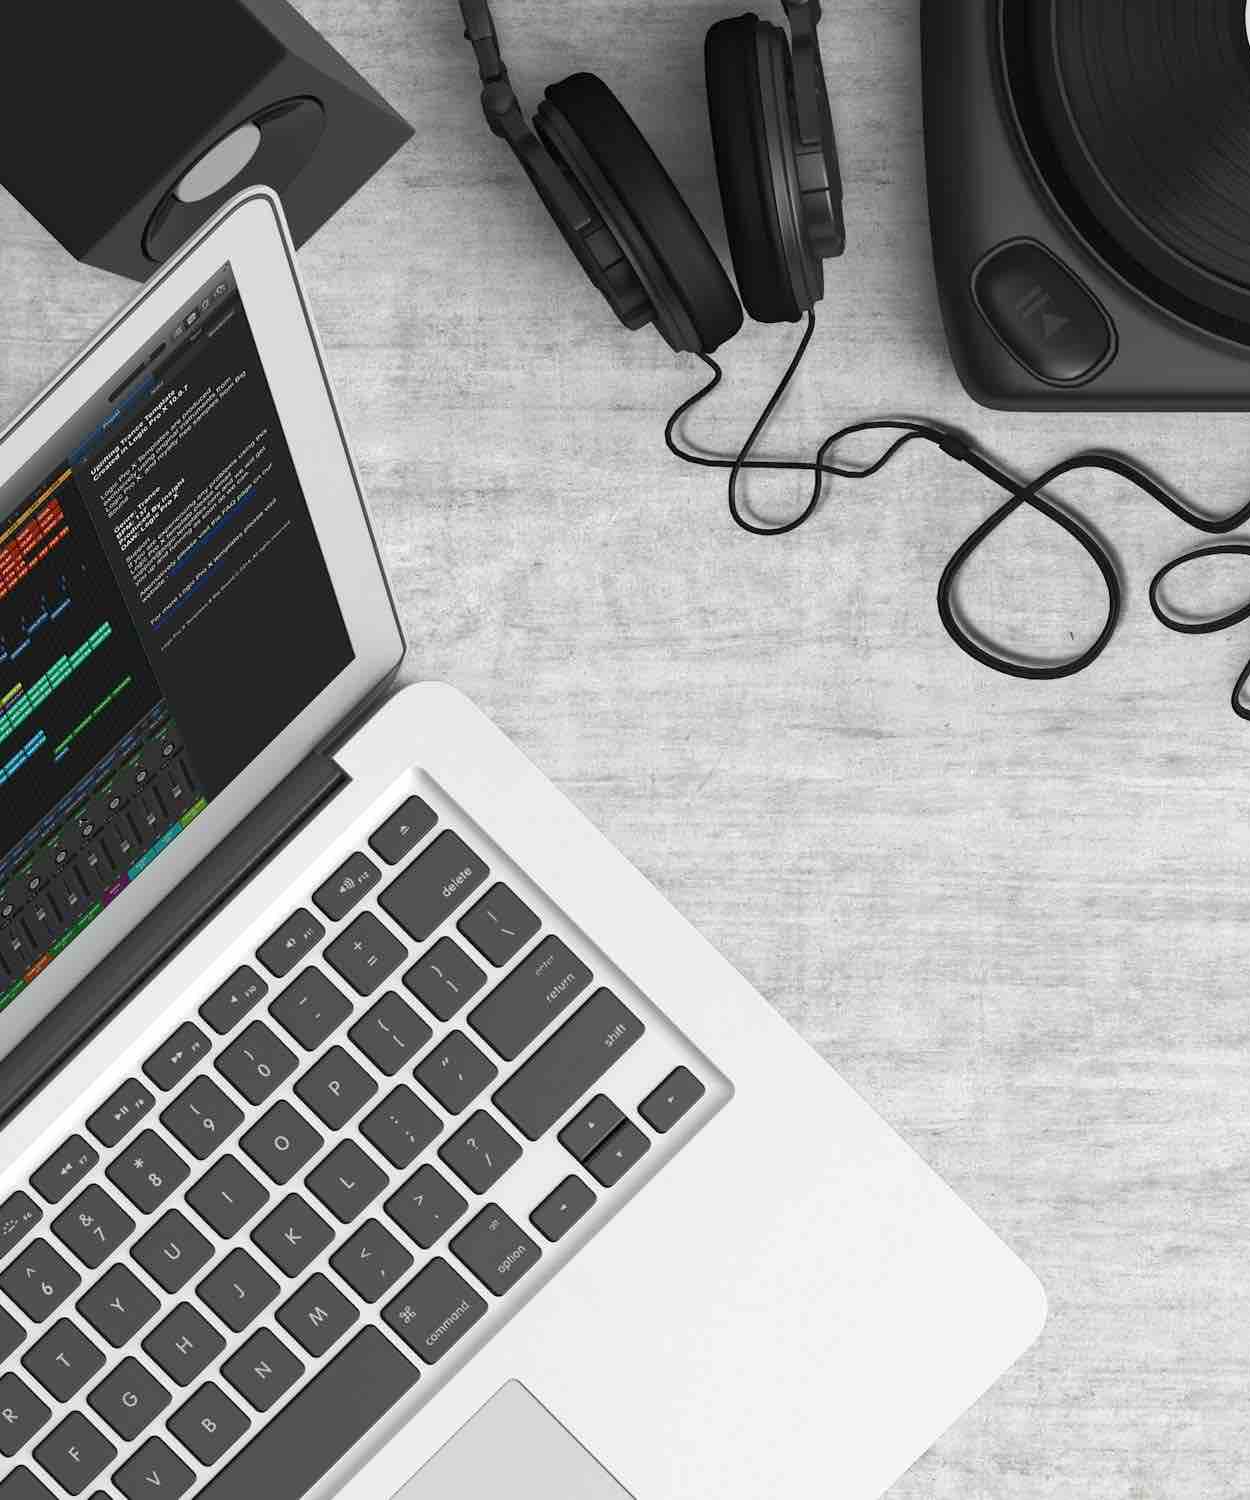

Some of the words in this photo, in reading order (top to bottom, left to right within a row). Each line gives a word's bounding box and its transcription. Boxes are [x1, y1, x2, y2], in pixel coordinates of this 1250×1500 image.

[90, 443, 120, 476] Uplifting
[119, 420, 143, 447] Trance
[144, 387, 176, 422] Template
[92, 451, 120, 482] Created
[128, 423, 148, 447] Logic
[148, 410, 161, 426] Pro
[161, 404, 168, 413] X
[137, 484, 161, 510] Trance
[140, 509, 160, 533] Logic
[159, 497, 173, 513] Pro
[442, 866, 473, 897] delete
[546, 972, 576, 1003] return
[604, 1023, 627, 1048] shift
[328, 1081, 340, 1096] P
[203, 1118, 215, 1131] 9
[274, 1136, 289, 1151] O
[148, 1173, 163, 1187] 8
[339, 1177, 355, 1189] L
[93, 1228, 107, 1242] 7
[284, 1228, 302, 1246] K
[164, 1243, 181, 1261] U
[497, 1244, 526, 1274] option
[41, 1282, 54, 1296] 6
[233, 1283, 246, 1299] J
[110, 1297, 126, 1312] Y
[309, 1307, 328, 1328] M
[425, 1300, 471, 1347] command
[176, 1336, 193, 1354] H
[56, 1353, 71, 1368] T
[254, 1361, 272, 1379] N
[122, 1392, 138, 1407] G
[1, 1408, 18, 1423] R
[201, 1418, 217, 1433] B
[68, 1446, 81, 1462] F
[145, 1471, 160, 1487] V
